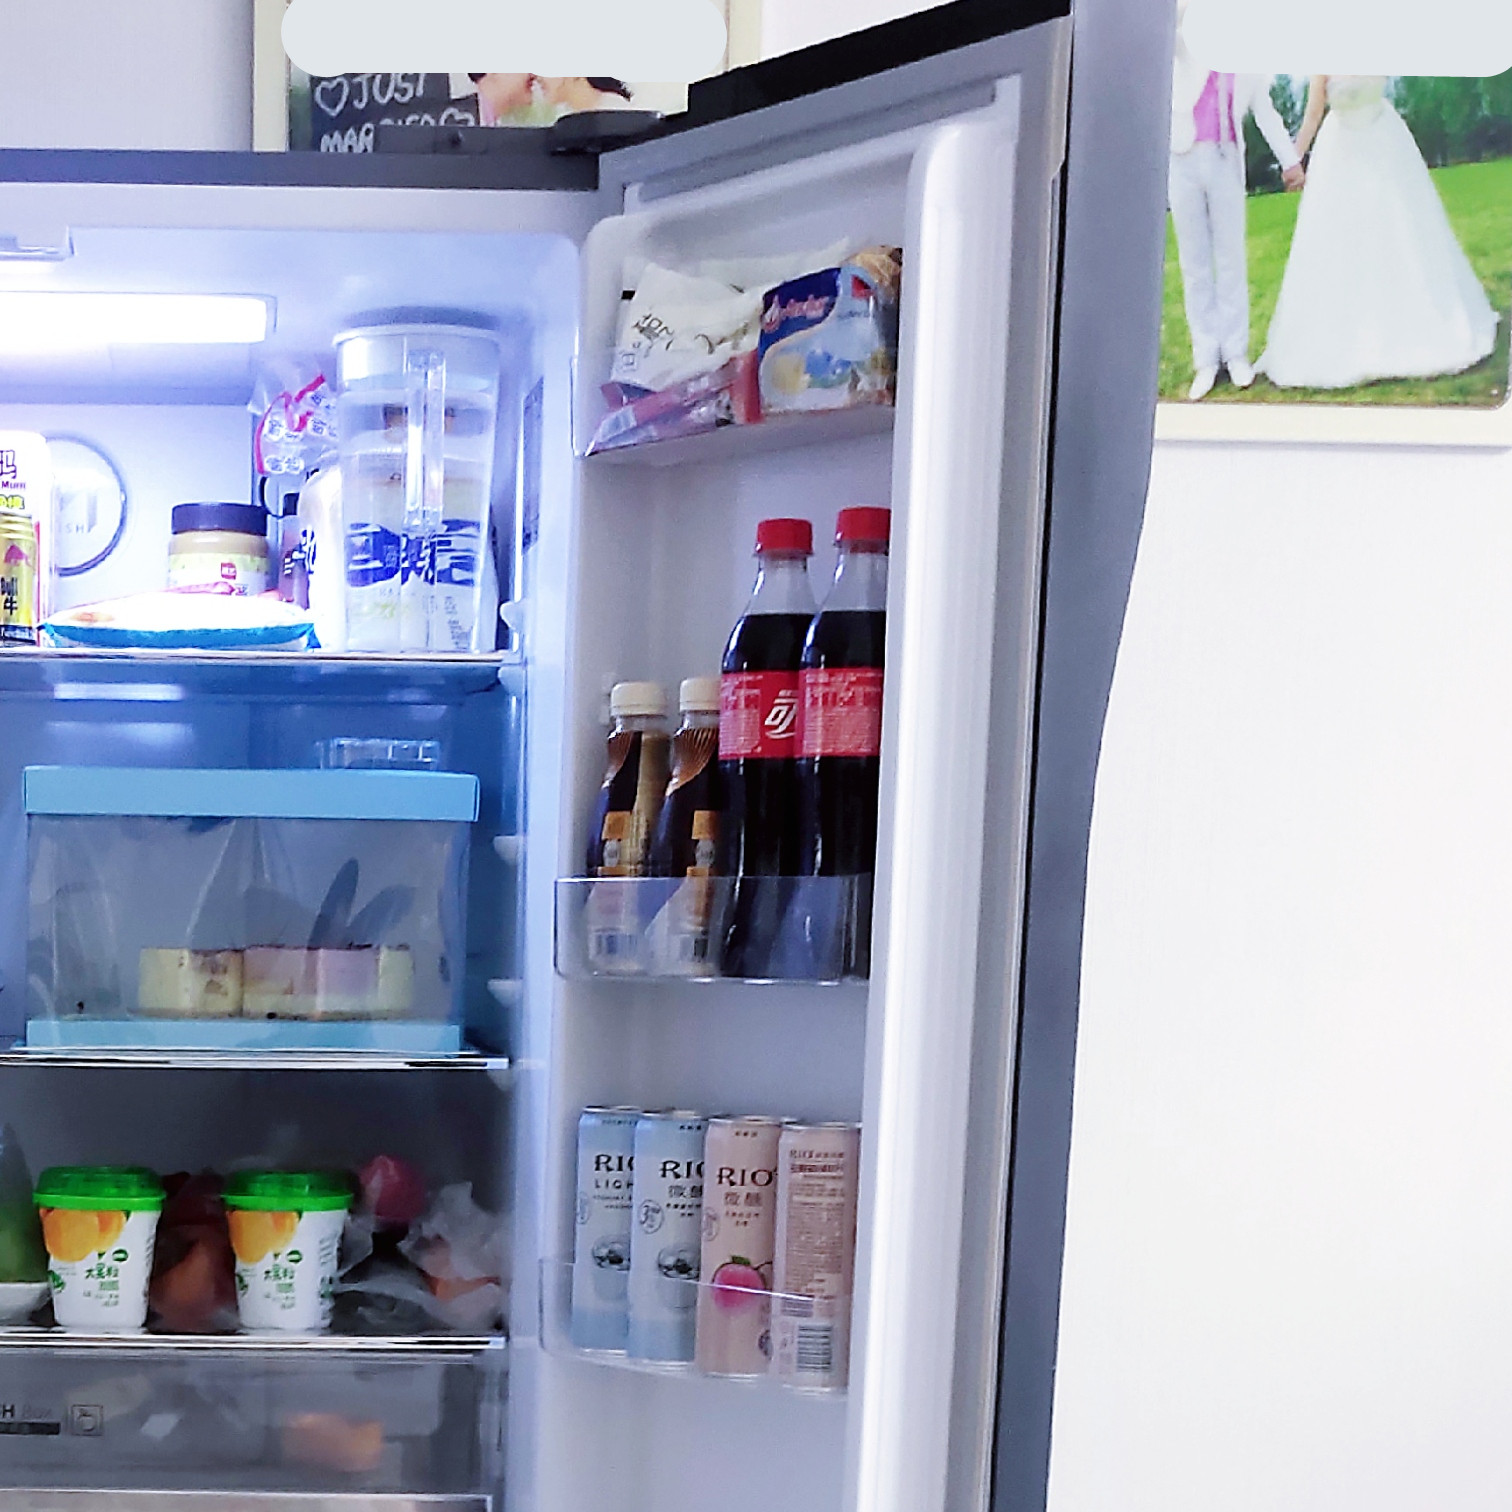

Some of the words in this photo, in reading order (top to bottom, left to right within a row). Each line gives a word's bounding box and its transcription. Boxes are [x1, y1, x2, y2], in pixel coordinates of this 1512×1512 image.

[1, 480, 26, 490] Mum
[717, 1166, 773, 1187] RIO
[594, 1179, 634, 1189] LIGH
